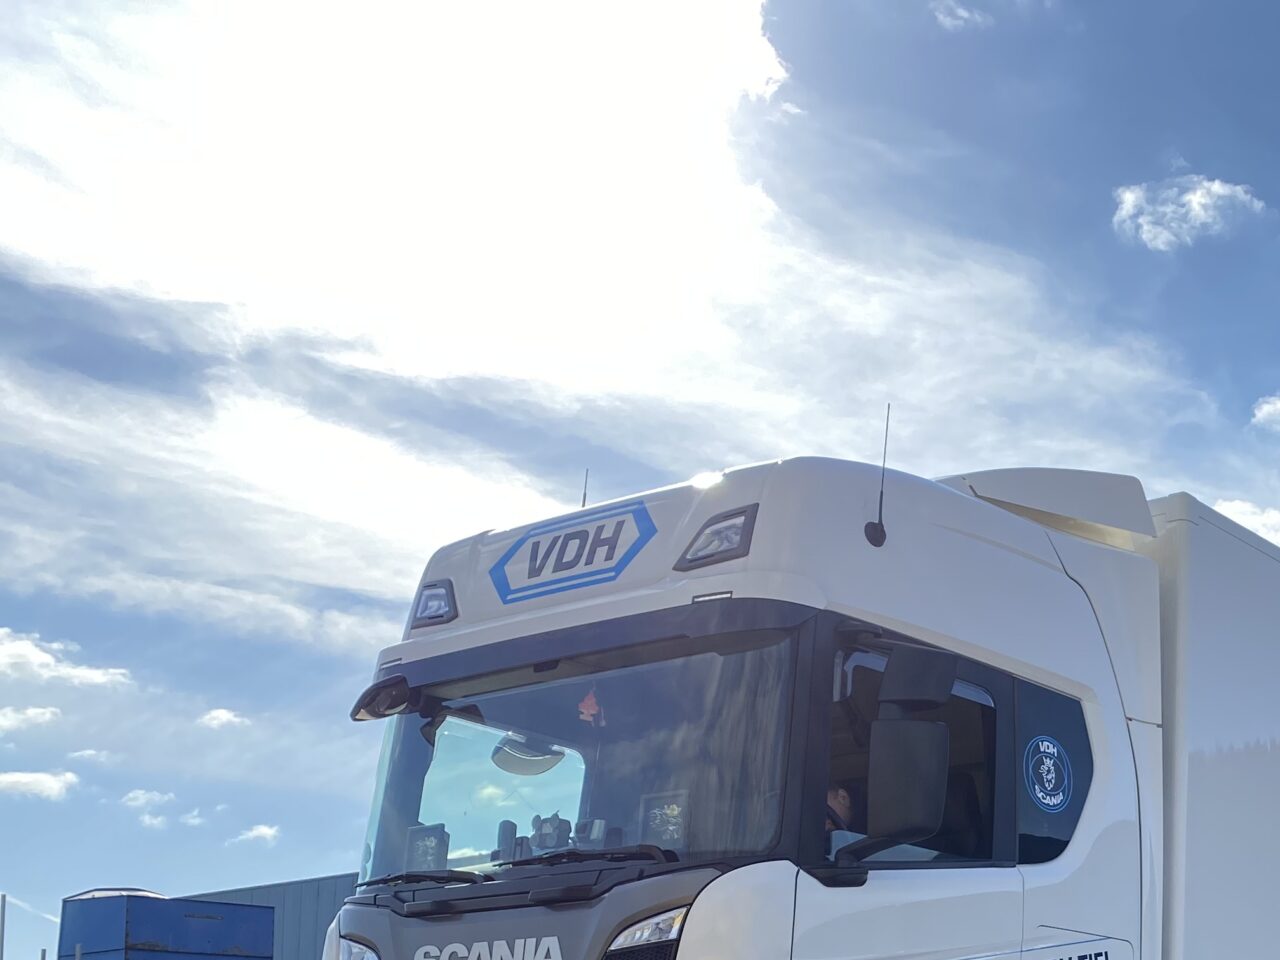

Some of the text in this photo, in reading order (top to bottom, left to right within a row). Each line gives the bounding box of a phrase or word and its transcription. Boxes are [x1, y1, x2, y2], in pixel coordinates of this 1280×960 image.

[527, 519, 626, 579] VDH
[1038, 741, 1058, 757] VDH
[1034, 784, 1064, 806] SCANIA
